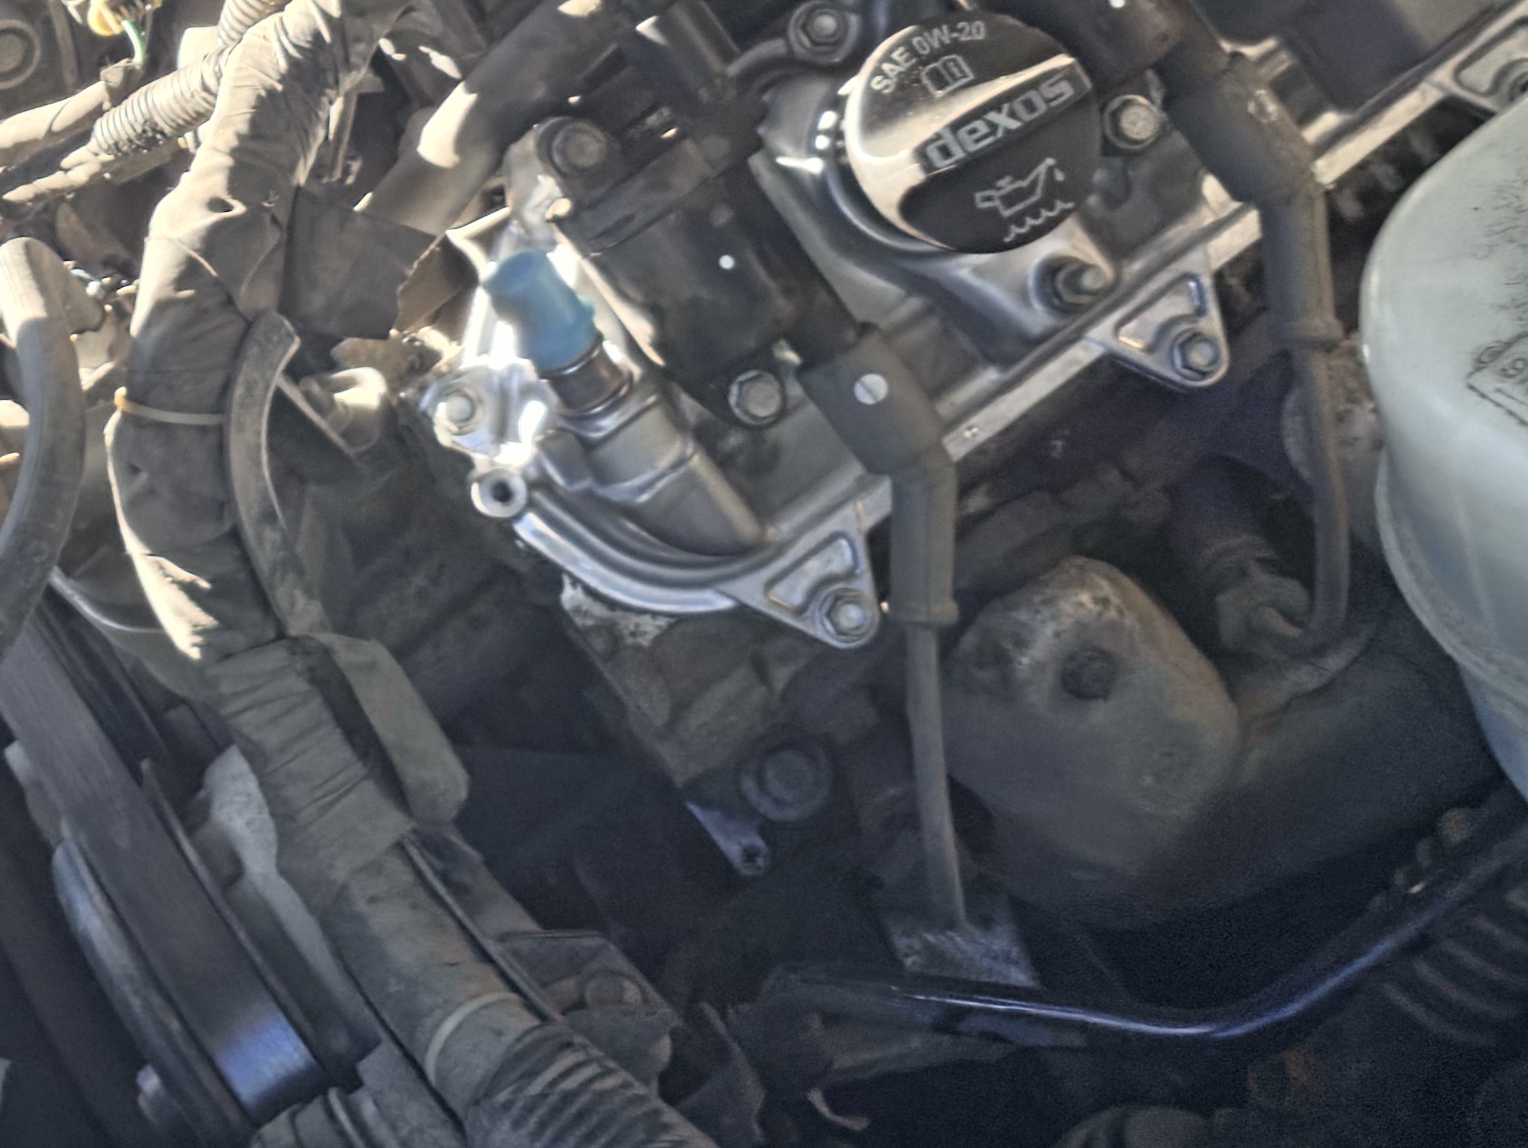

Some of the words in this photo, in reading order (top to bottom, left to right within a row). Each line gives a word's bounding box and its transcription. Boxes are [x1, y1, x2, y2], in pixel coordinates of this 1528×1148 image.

[870, 46, 917, 93] SAE
[912, 20, 986, 55] 0W-20
[926, 74, 1075, 168] dexos
